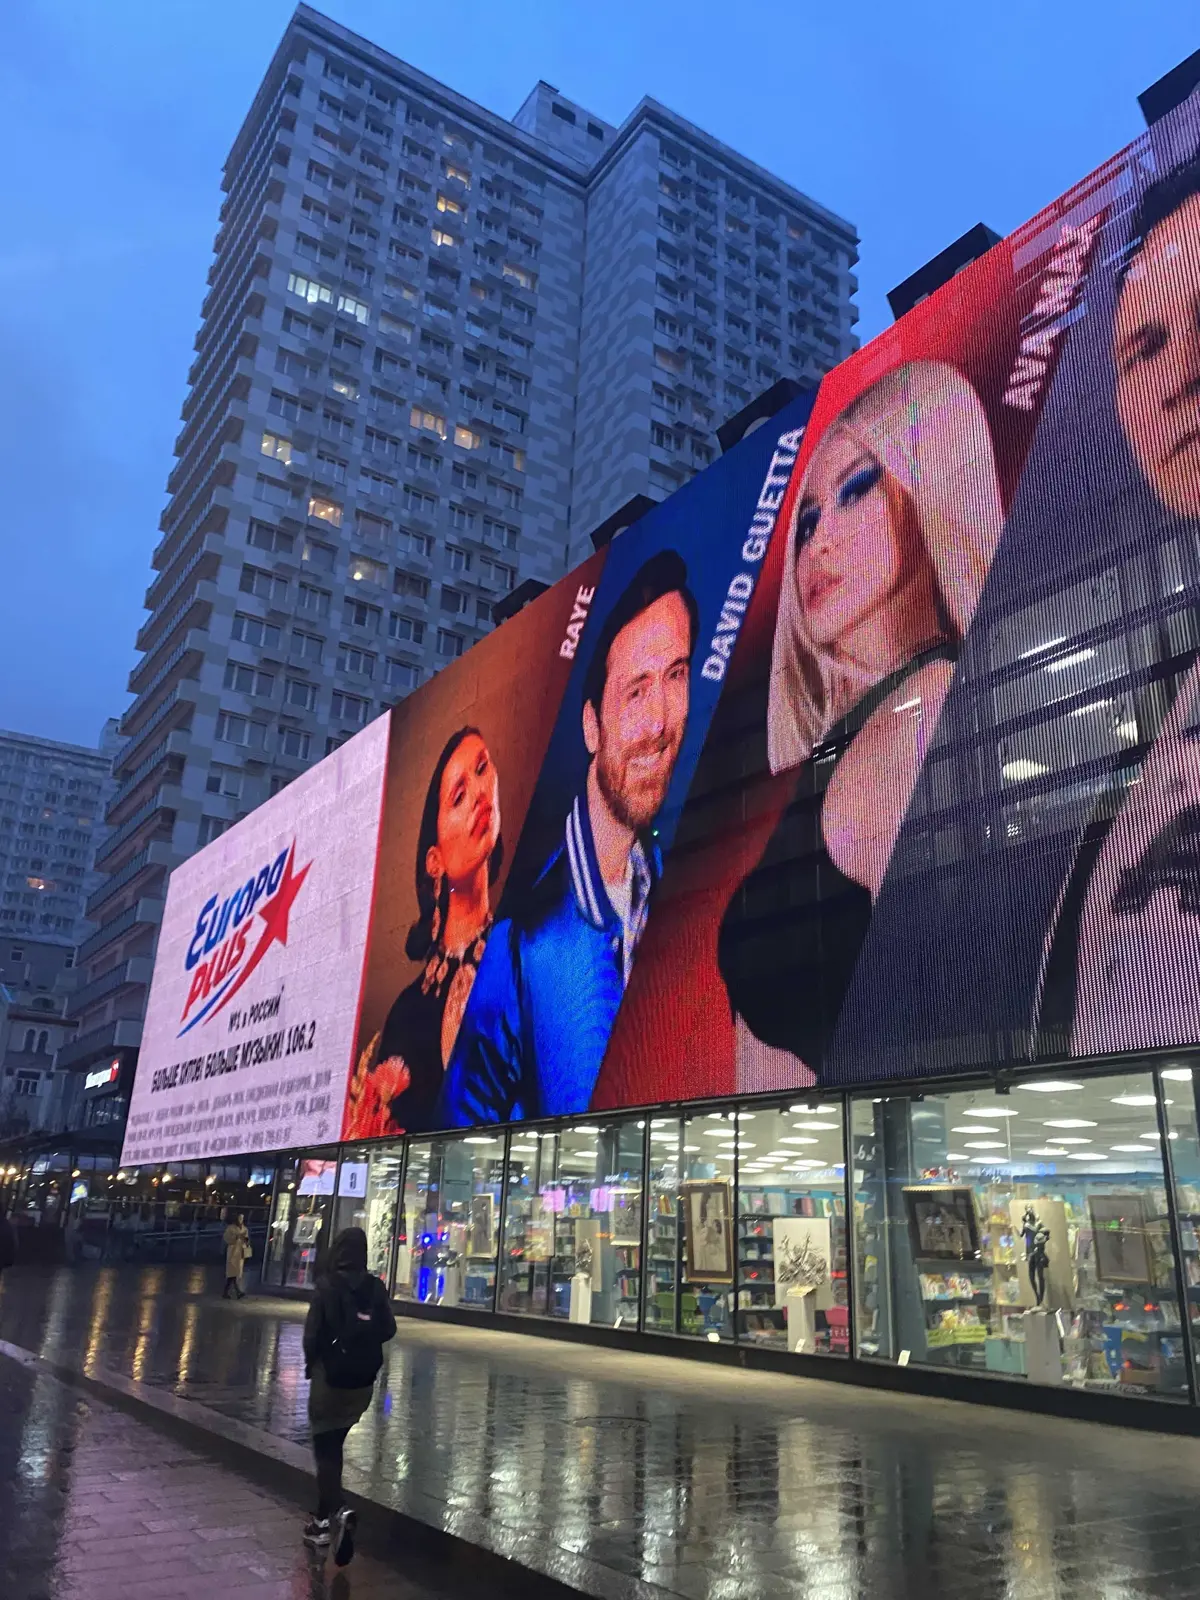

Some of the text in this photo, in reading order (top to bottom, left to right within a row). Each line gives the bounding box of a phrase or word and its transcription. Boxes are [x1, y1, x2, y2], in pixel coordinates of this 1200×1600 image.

[701, 426, 806, 681] DAVID GUETTA
[559, 584, 595, 660] RAYE
[204, 1044, 241, 1080] БОЛЬШЕ
[286, 1019, 316, 1056] 106.2
